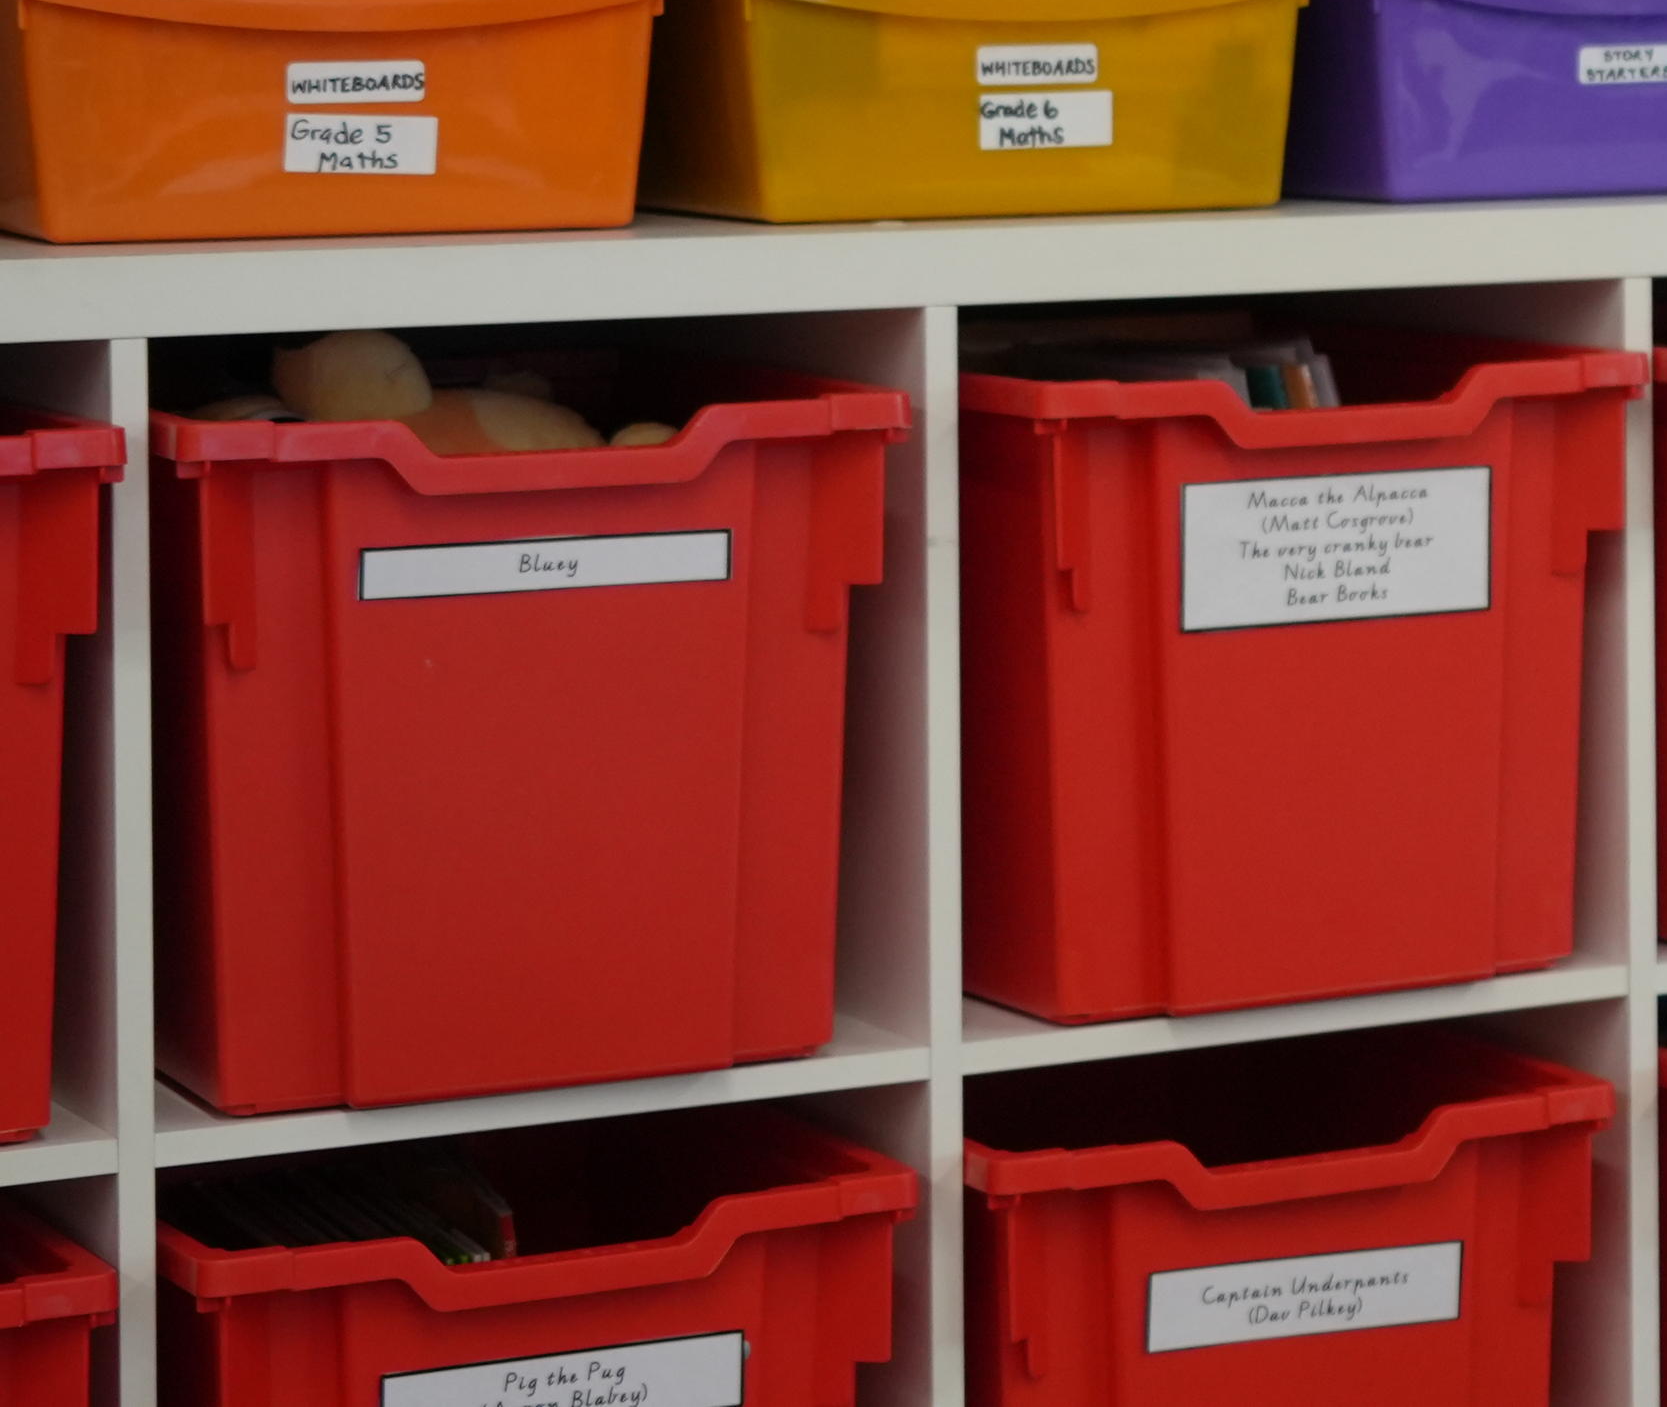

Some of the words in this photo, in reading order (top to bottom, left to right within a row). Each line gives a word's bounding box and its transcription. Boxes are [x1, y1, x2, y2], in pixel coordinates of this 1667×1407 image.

[980, 57, 1096, 77] WHITEBOARDS
[1603, 48, 1655, 63] STORY
[291, 73, 426, 95] WHITEBOARDS
[979, 99, 1038, 120] Grade
[1043, 99, 1060, 120] 6
[291, 118, 364, 145] Grade
[375, 124, 393, 145] 5
[1000, 125, 1066, 148] Maths
[317, 150, 399, 173] Maths
[1248, 491, 1310, 510] Macca
[1317, 489, 1345, 506] the
[1261, 514, 1319, 535] (Matt
[1325, 507, 1415, 534] Cosgrove)
[1239, 540, 1271, 560] The
[1278, 544, 1318, 562] very
[1323, 539, 1389, 558] cranky
[1394, 532, 1435, 550] bear
[518, 553, 579, 578] Bluey
[1284, 561, 1327, 582] Nick
[1333, 557, 1392, 578] Bland
[1286, 587, 1330, 607] Bear
[1336, 583, 1389, 602] Books
[1200, 1285, 1283, 1309] Captain
[1290, 1270, 1410, 1297] Underpants
[1247, 1303, 1291, 1325] (Dav
[1298, 1297, 1364, 1322] Pilkey)
[503, 1372, 537, 1397] Pig
[547, 1366, 578, 1387] the
[586, 1361, 626, 1386] Pug
[570, 1382, 648, 1407] Blabey)
